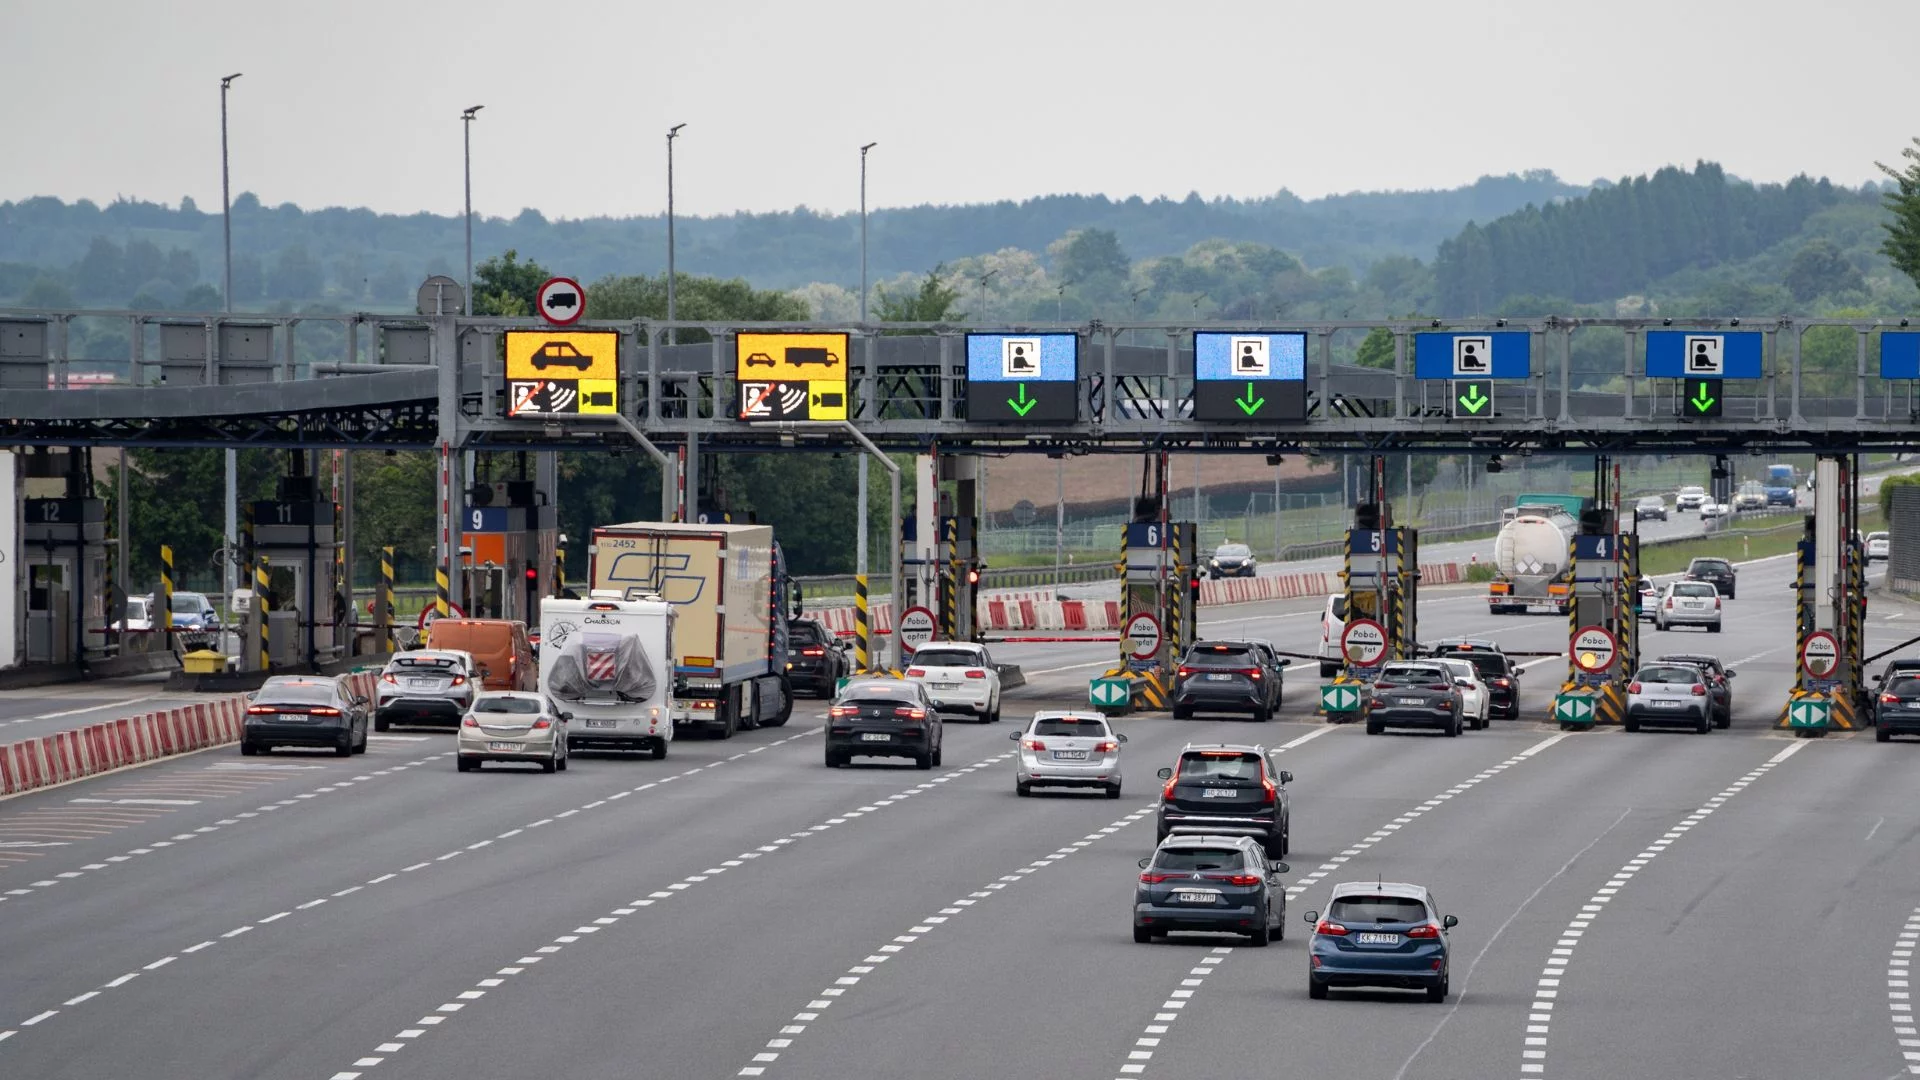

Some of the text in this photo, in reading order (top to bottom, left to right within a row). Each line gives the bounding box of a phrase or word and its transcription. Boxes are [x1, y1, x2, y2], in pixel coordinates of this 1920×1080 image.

[41, 502, 59, 521] 12
[276, 504, 291, 523] 11
[472, 509, 482, 530] 9
[613, 539, 636, 549] 2452
[1148, 525, 1157, 546] 6
[1371, 532, 1380, 551] 5
[1596, 538, 1606, 557] 4
